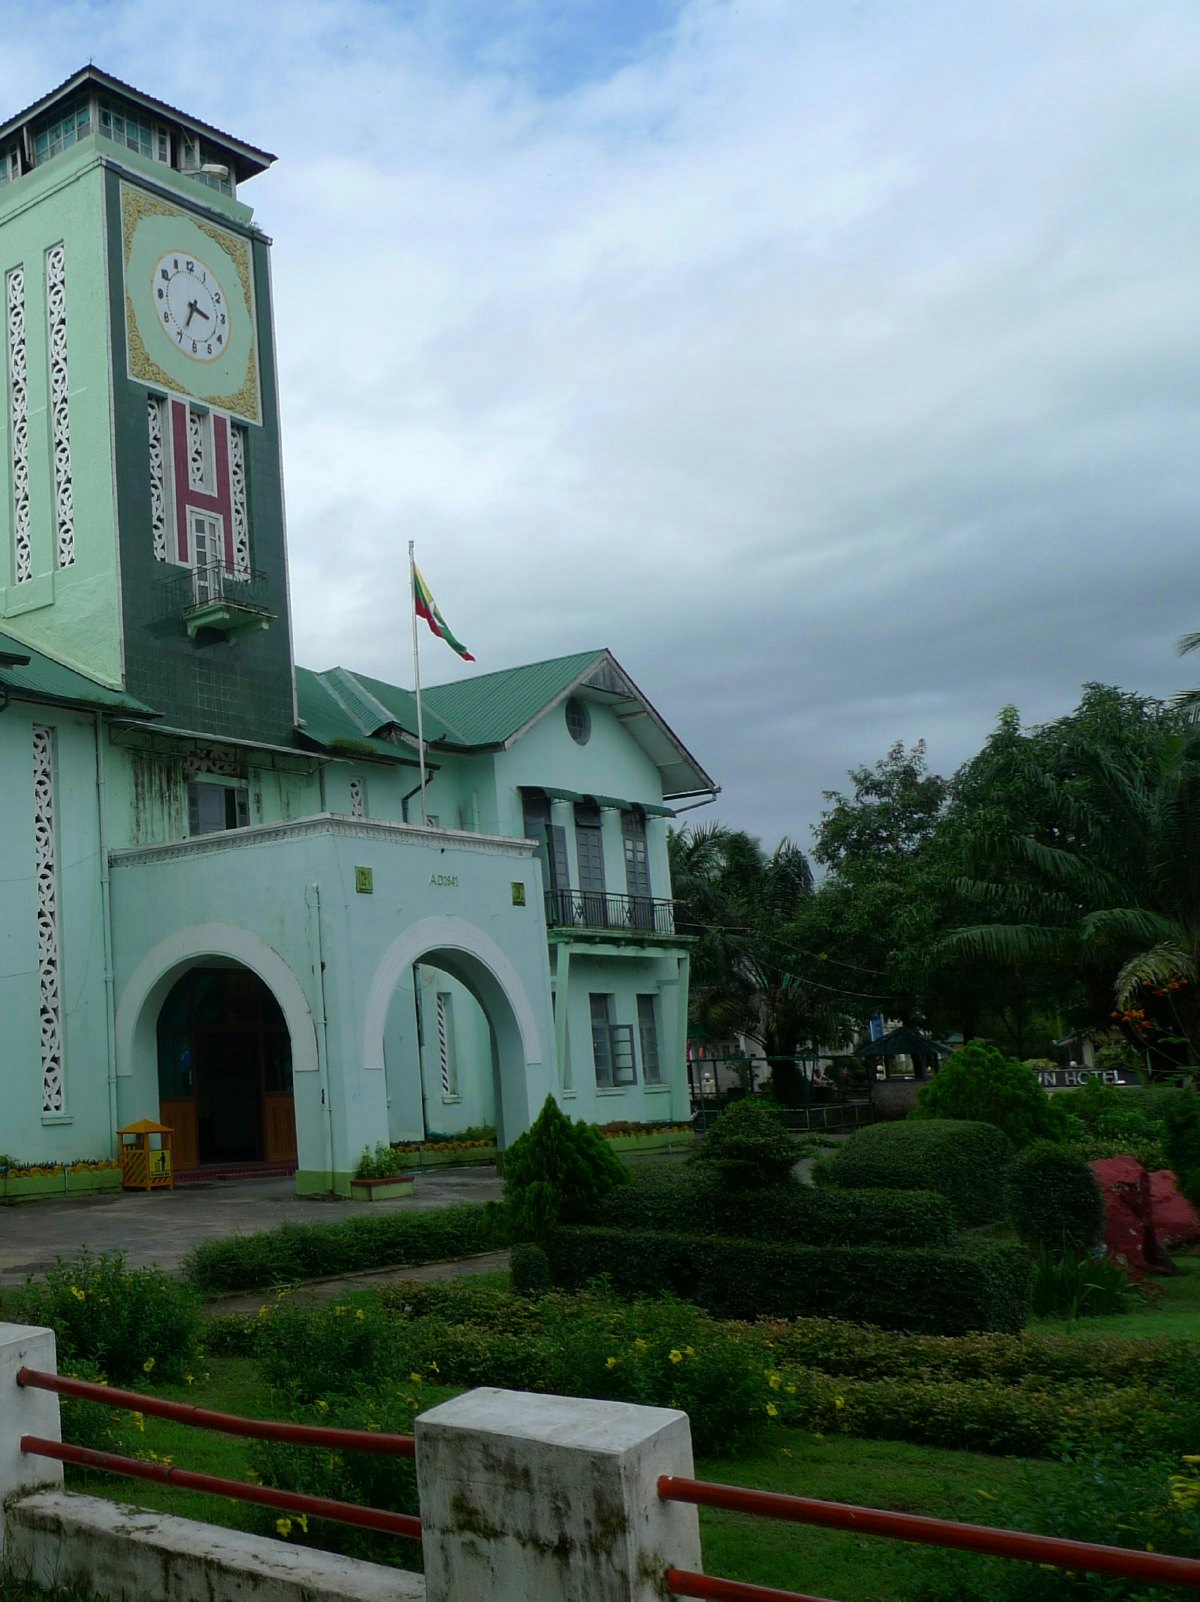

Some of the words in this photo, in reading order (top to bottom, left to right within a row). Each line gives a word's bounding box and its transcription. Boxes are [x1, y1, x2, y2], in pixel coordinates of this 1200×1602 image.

[186, 260, 194, 272] 12
[214, 292, 221, 304] 2
[163, 312, 169, 323] 8
[220, 313, 226, 324] 3
[177, 331, 182, 343] 7
[216, 334, 222, 345] 4
[192, 340, 197, 353] 6
[207, 344, 212, 354] 5
